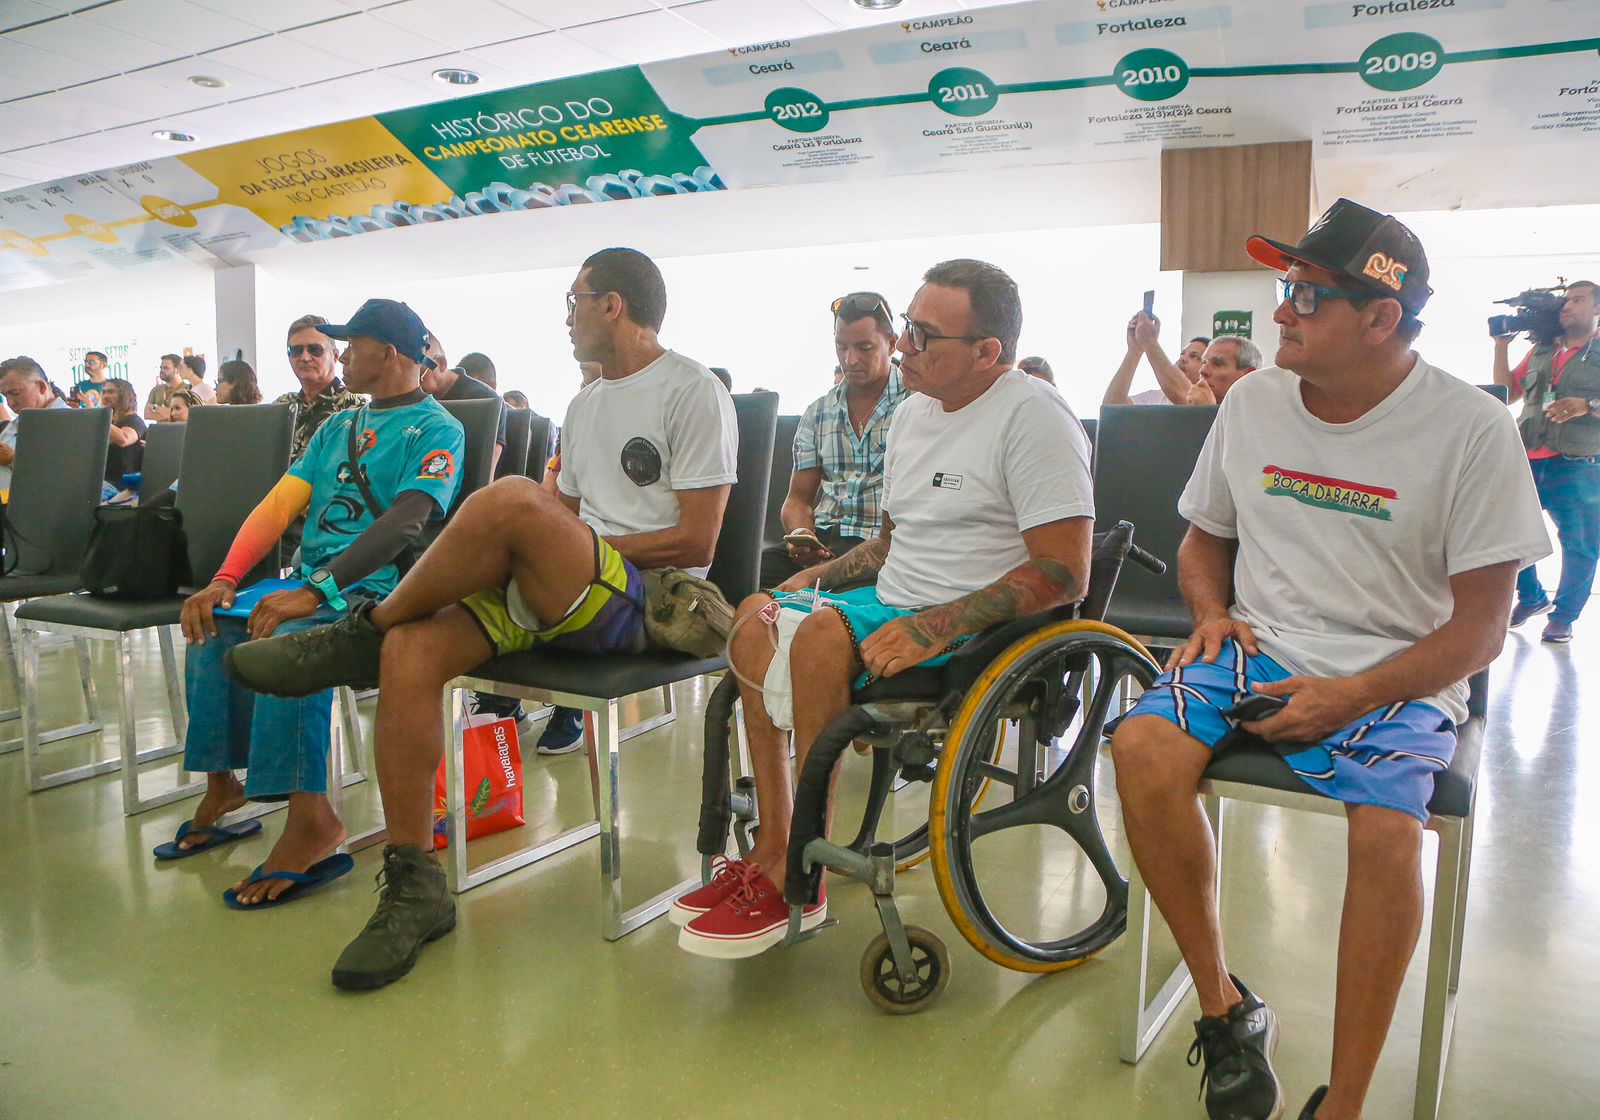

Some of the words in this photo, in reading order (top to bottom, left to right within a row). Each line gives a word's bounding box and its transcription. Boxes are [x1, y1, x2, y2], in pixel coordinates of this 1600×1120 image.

[1352, 0, 1456, 17] Fortaleza
[1096, 16, 1187, 35] Fortaleza
[920, 37, 972, 53] Ceará
[749, 59, 795, 74] Ceará
[1365, 51, 1437, 75] 2009
[1122, 65, 1181, 86] 2010
[938, 83, 989, 103] 2011
[772, 102, 822, 121] 2012
[1088, 112, 1143, 124] Fortaleza
[1196, 106, 1232, 115] Ceará
[1336, 102, 1398, 115] Fortaleza
[1422, 97, 1464, 108] Ceará
[431, 105, 563, 140] HISTÓRICO
[565, 97, 613, 120] DO
[423, 129, 557, 161] CAMPEONATO
[561, 114, 668, 142] CEARENSE
[922, 127, 954, 137] Ceará
[256, 148, 328, 174] JOGOS
[498, 154, 526, 170] DE
[530, 143, 612, 168] FUTEBOL
[240, 182, 267, 196] DA
[262, 168, 328, 191] SELEÇÃO
[325, 153, 412, 178] BRASILEIRA
[286, 190, 312, 205] NO
[311, 176, 387, 200] CASTELÃO
[1273, 471, 1310, 497] BOCA
[493, 726, 517, 790] havaianas
